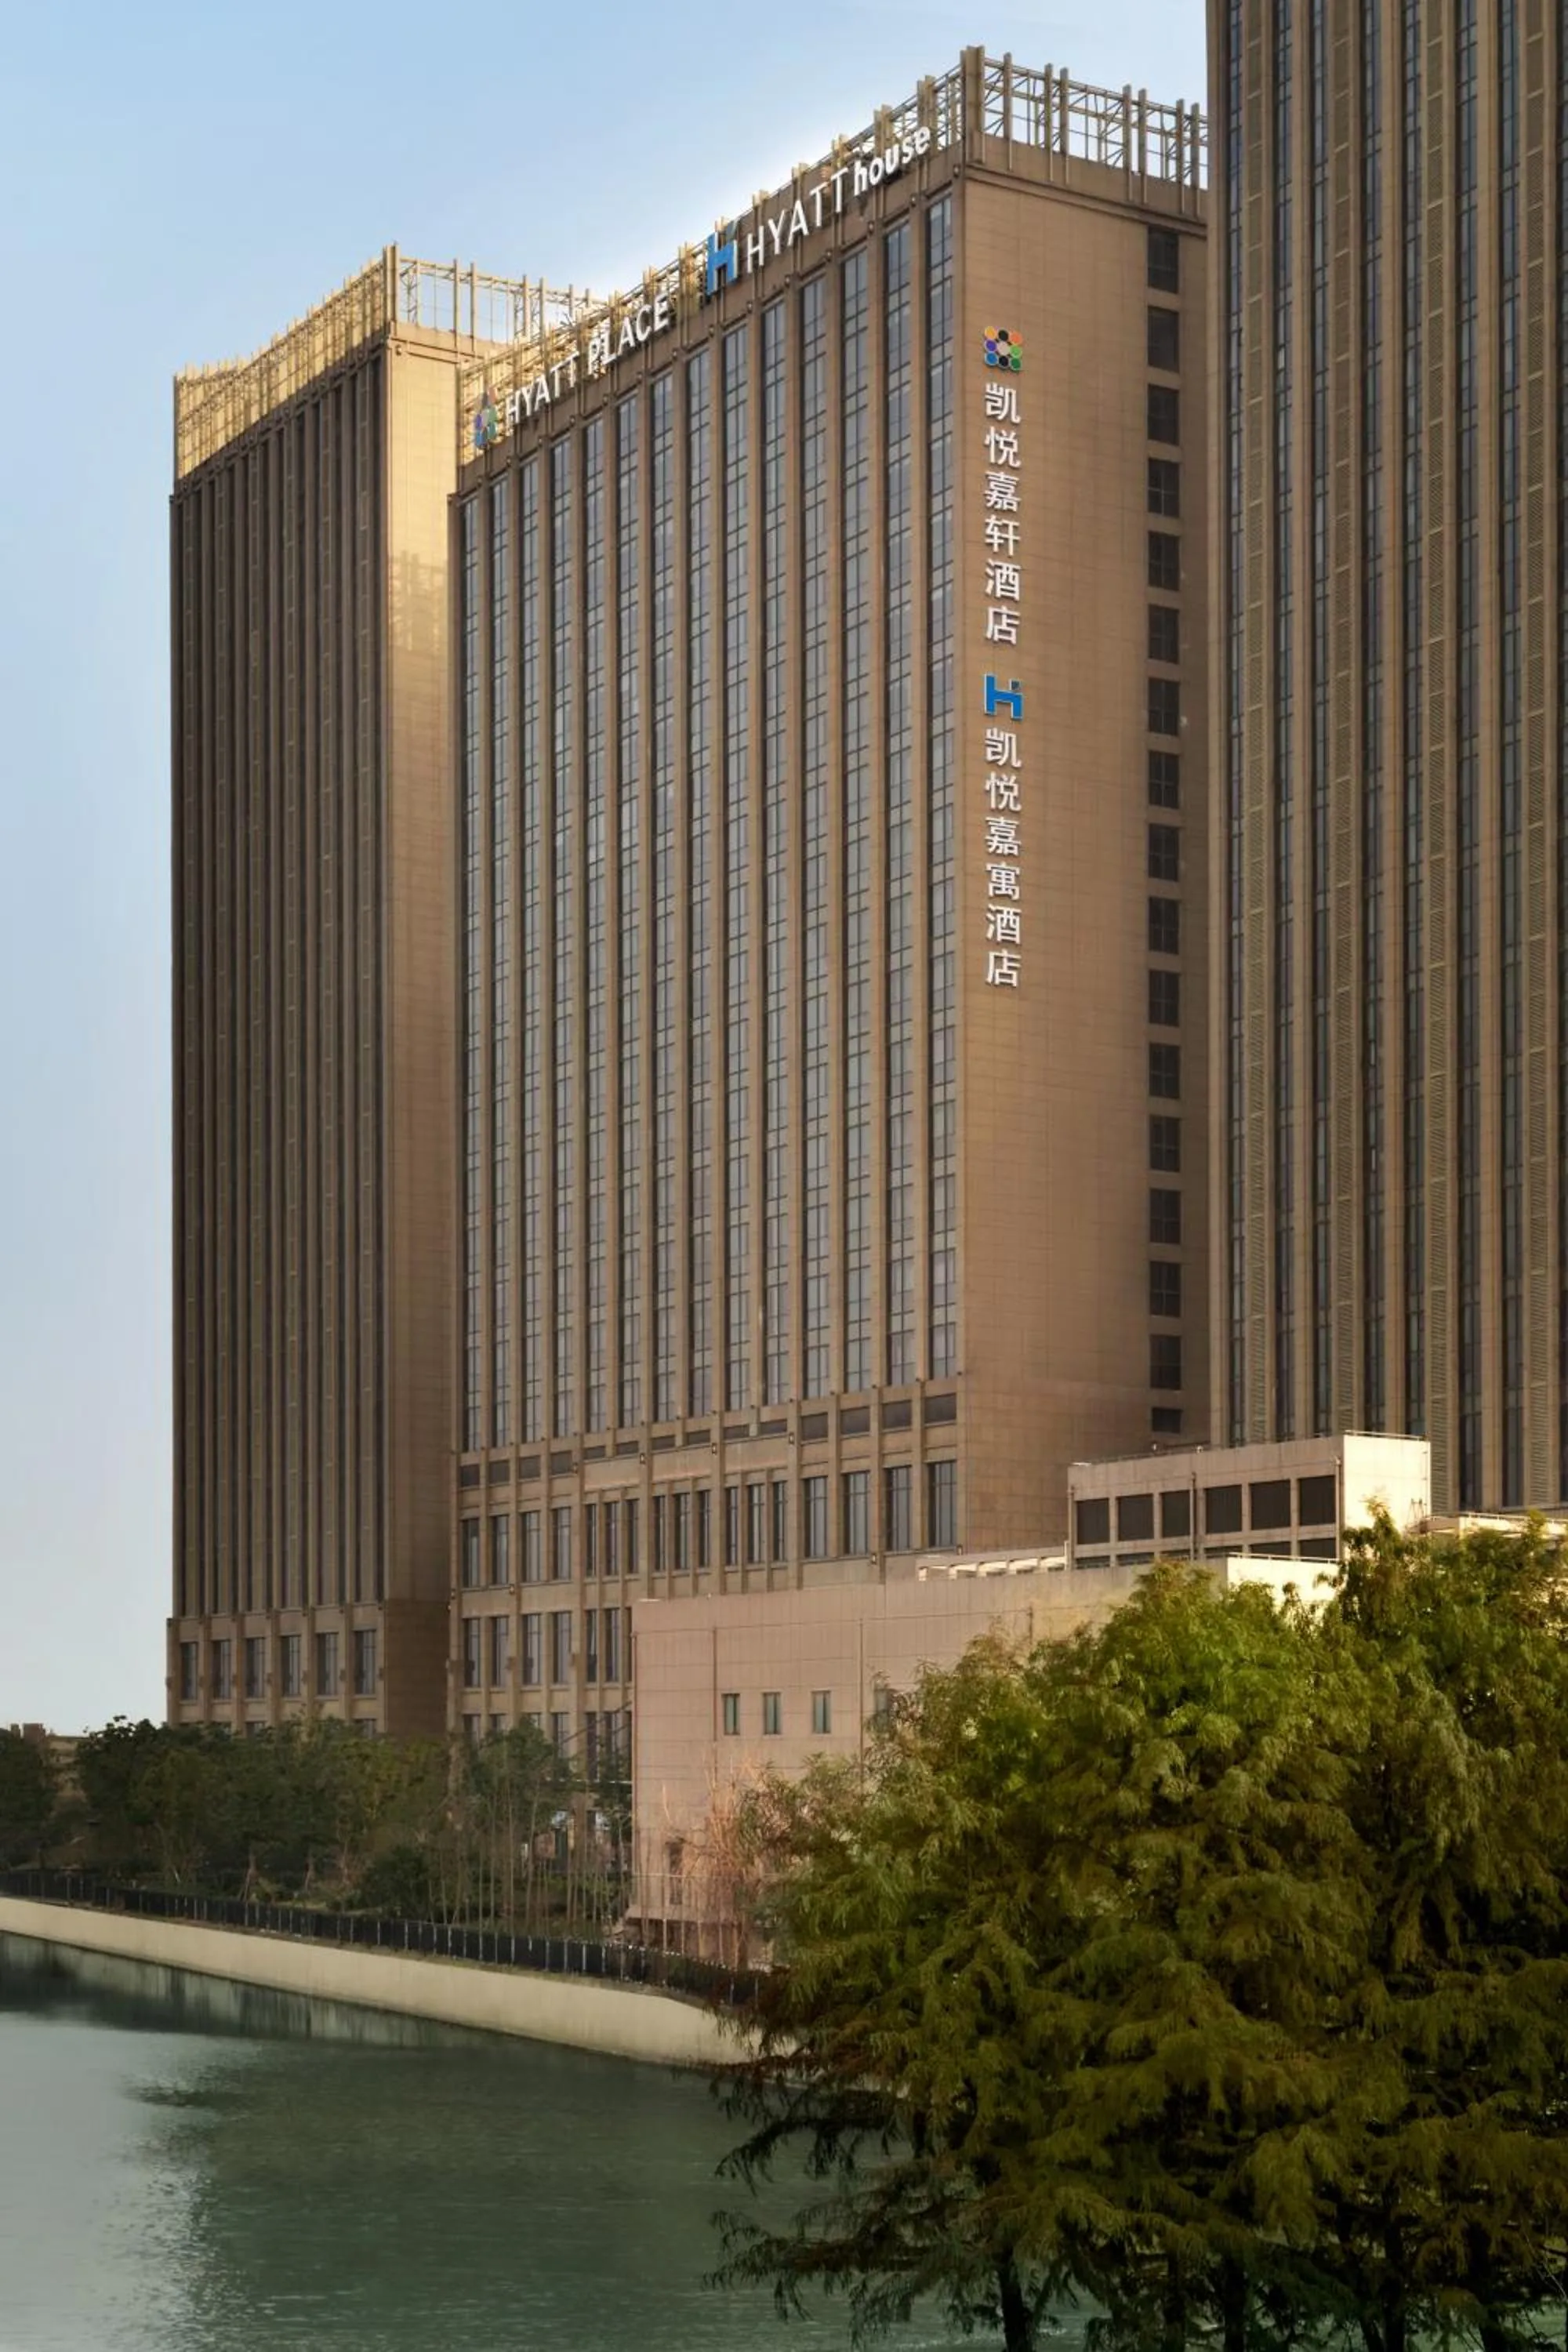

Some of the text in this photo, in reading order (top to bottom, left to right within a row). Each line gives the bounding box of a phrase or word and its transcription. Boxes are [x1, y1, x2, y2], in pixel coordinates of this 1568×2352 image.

[747, 168, 848, 274] HYATT
[854, 125, 931, 196] house
[506, 294, 670, 428] HYATT PLACE
[983, 382, 1022, 645] 凯悦嘉轩酒店
[984, 727, 1022, 987] 凯悦嘉寓酒店
